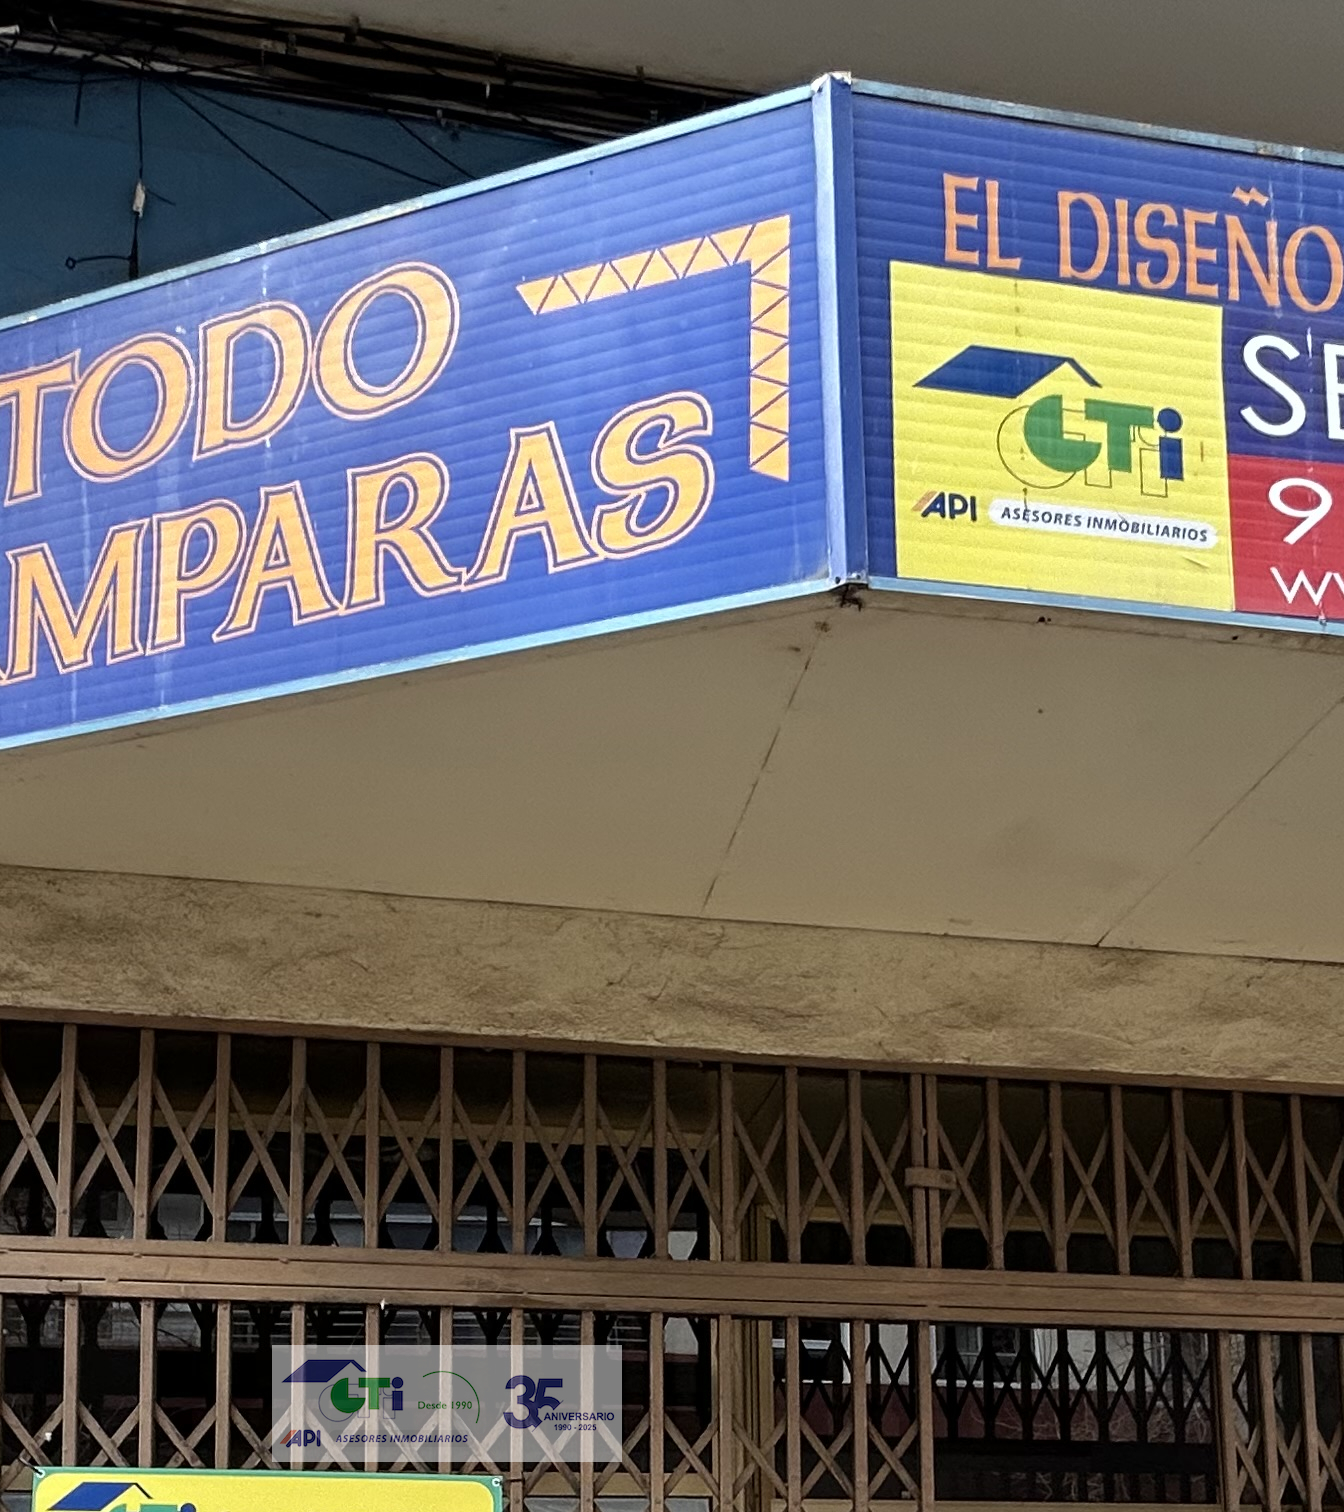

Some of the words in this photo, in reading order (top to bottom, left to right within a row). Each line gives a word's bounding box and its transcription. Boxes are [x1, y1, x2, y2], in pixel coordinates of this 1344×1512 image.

[942, 173, 1021, 269] EL
[1057, 186, 1344, 312] DISEÑO
[921, 491, 977, 522] API
[1001, 506, 1082, 528] ASESORES
[1087, 517, 1208, 543] INMOBILIARIOS
